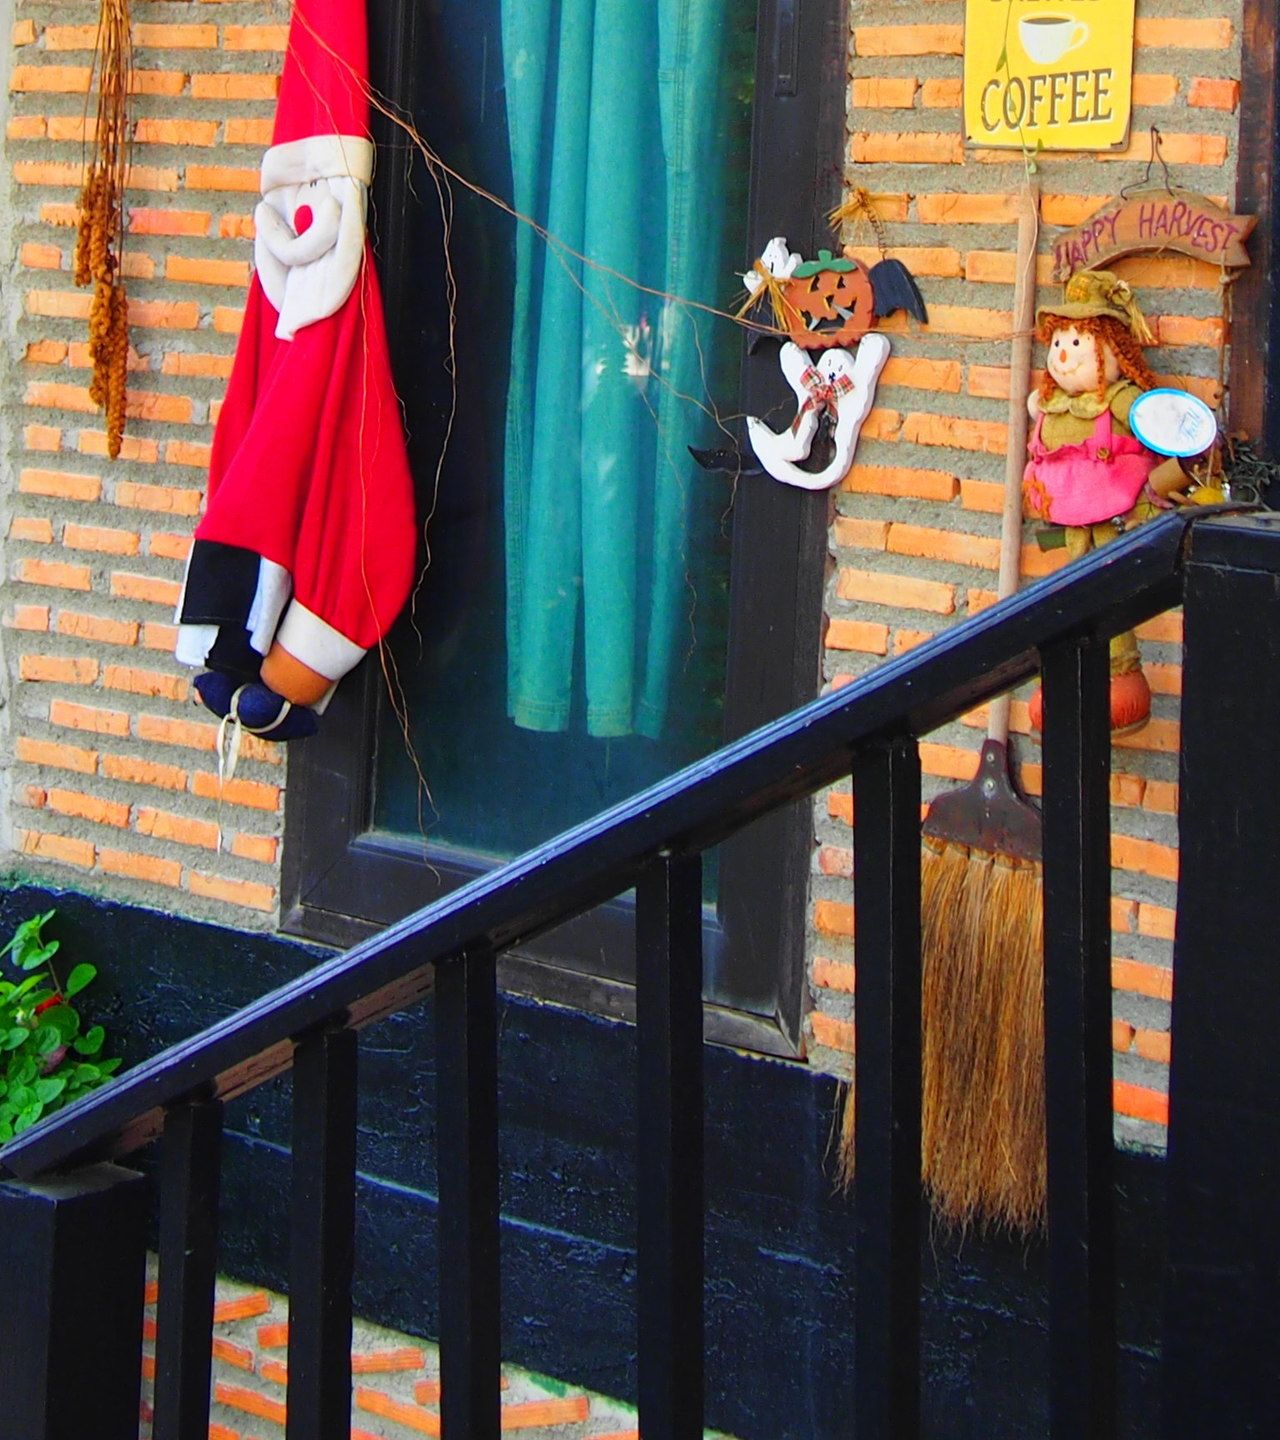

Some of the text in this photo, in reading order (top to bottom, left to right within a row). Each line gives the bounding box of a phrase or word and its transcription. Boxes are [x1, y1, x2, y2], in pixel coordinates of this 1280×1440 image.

[980, 68, 1113, 131] COFFEE
[1051, 200, 1239, 270] HAPPY HARVEST
